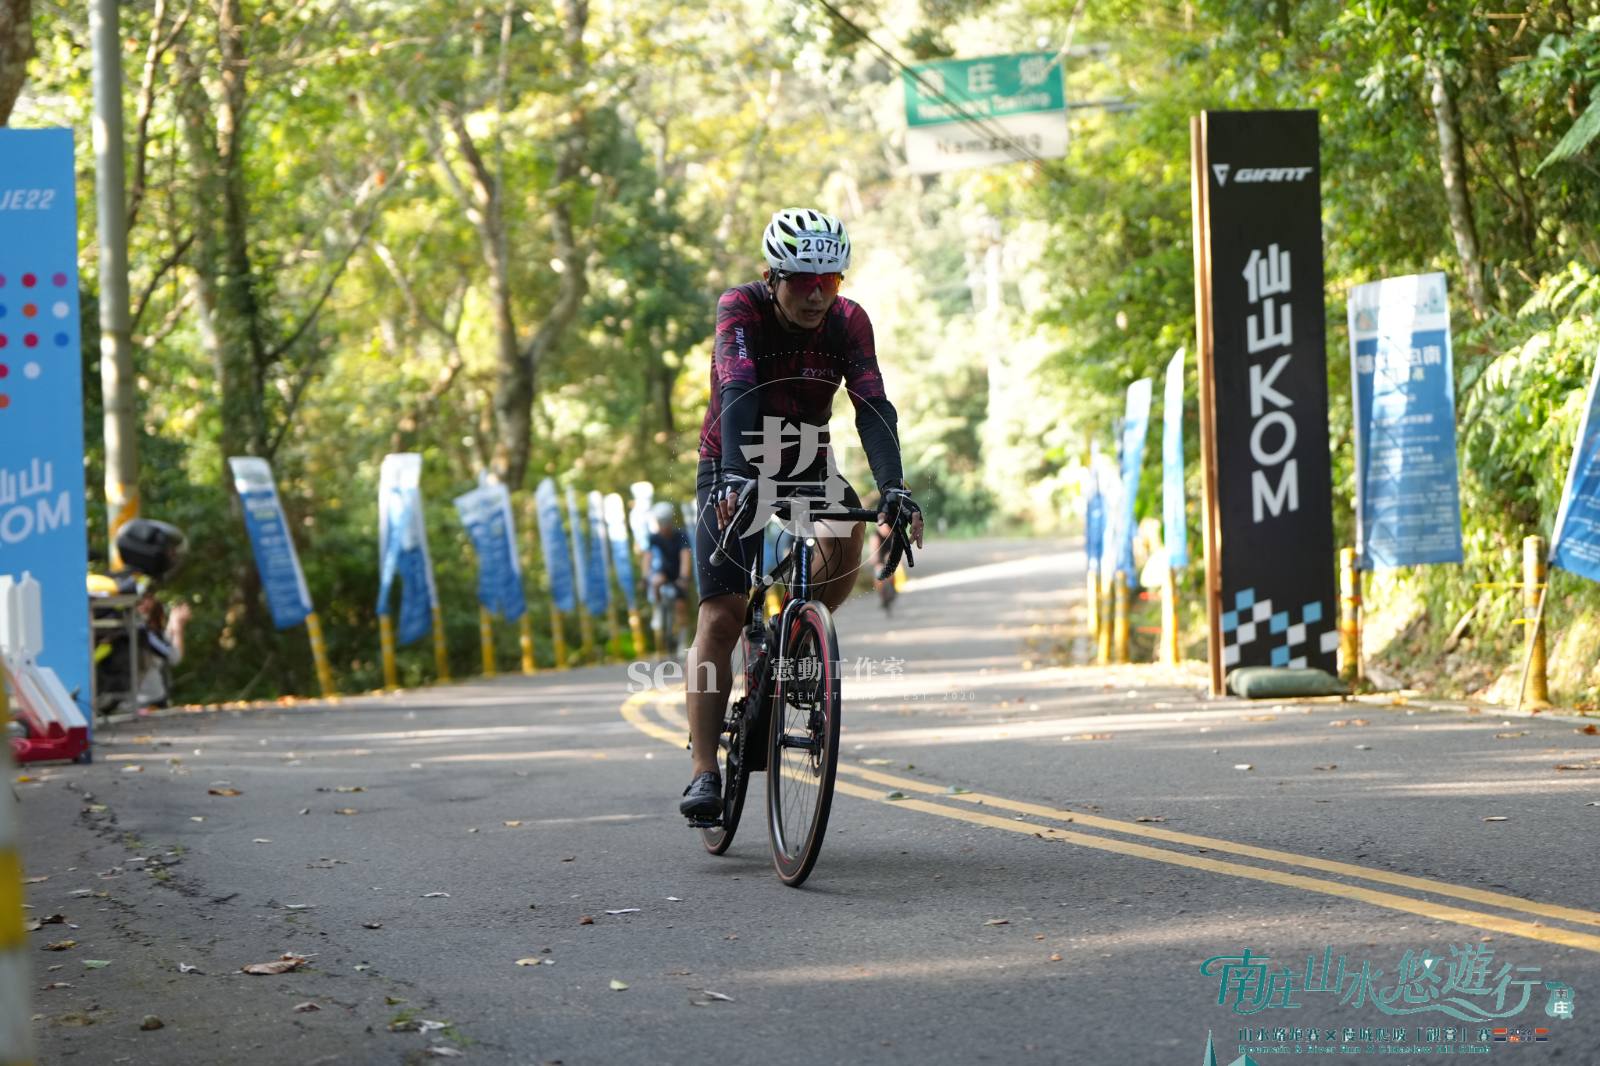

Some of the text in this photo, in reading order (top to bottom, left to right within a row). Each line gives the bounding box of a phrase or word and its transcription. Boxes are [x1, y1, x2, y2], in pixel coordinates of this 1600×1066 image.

[1233, 166, 1314, 183] GIANT
[800, 238, 840, 256] 2071
[0, 490, 71, 544] OM
